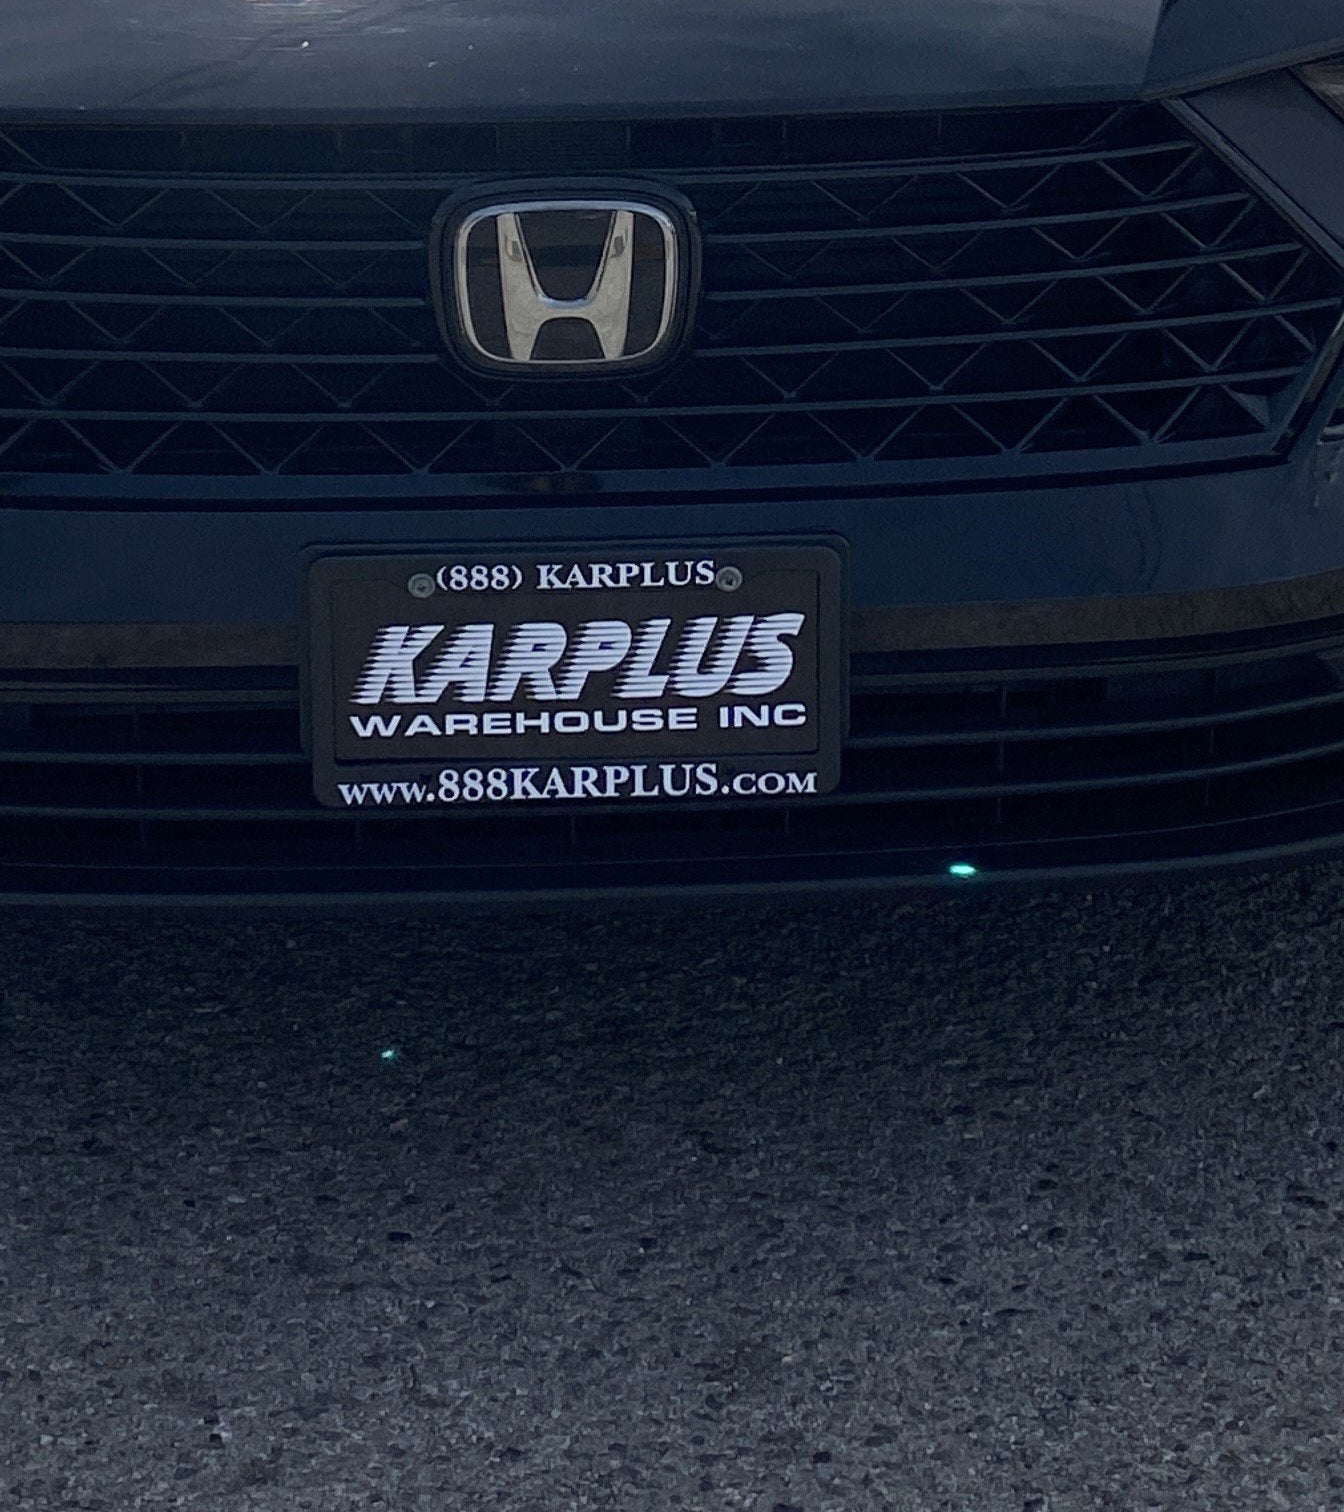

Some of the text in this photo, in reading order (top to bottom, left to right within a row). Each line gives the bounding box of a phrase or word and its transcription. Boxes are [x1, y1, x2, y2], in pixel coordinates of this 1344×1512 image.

[434, 559, 716, 593] (888) KARPLUS
[349, 612, 807, 706] KARPLUS
[349, 703, 808, 738] WAREHOUSE INC
